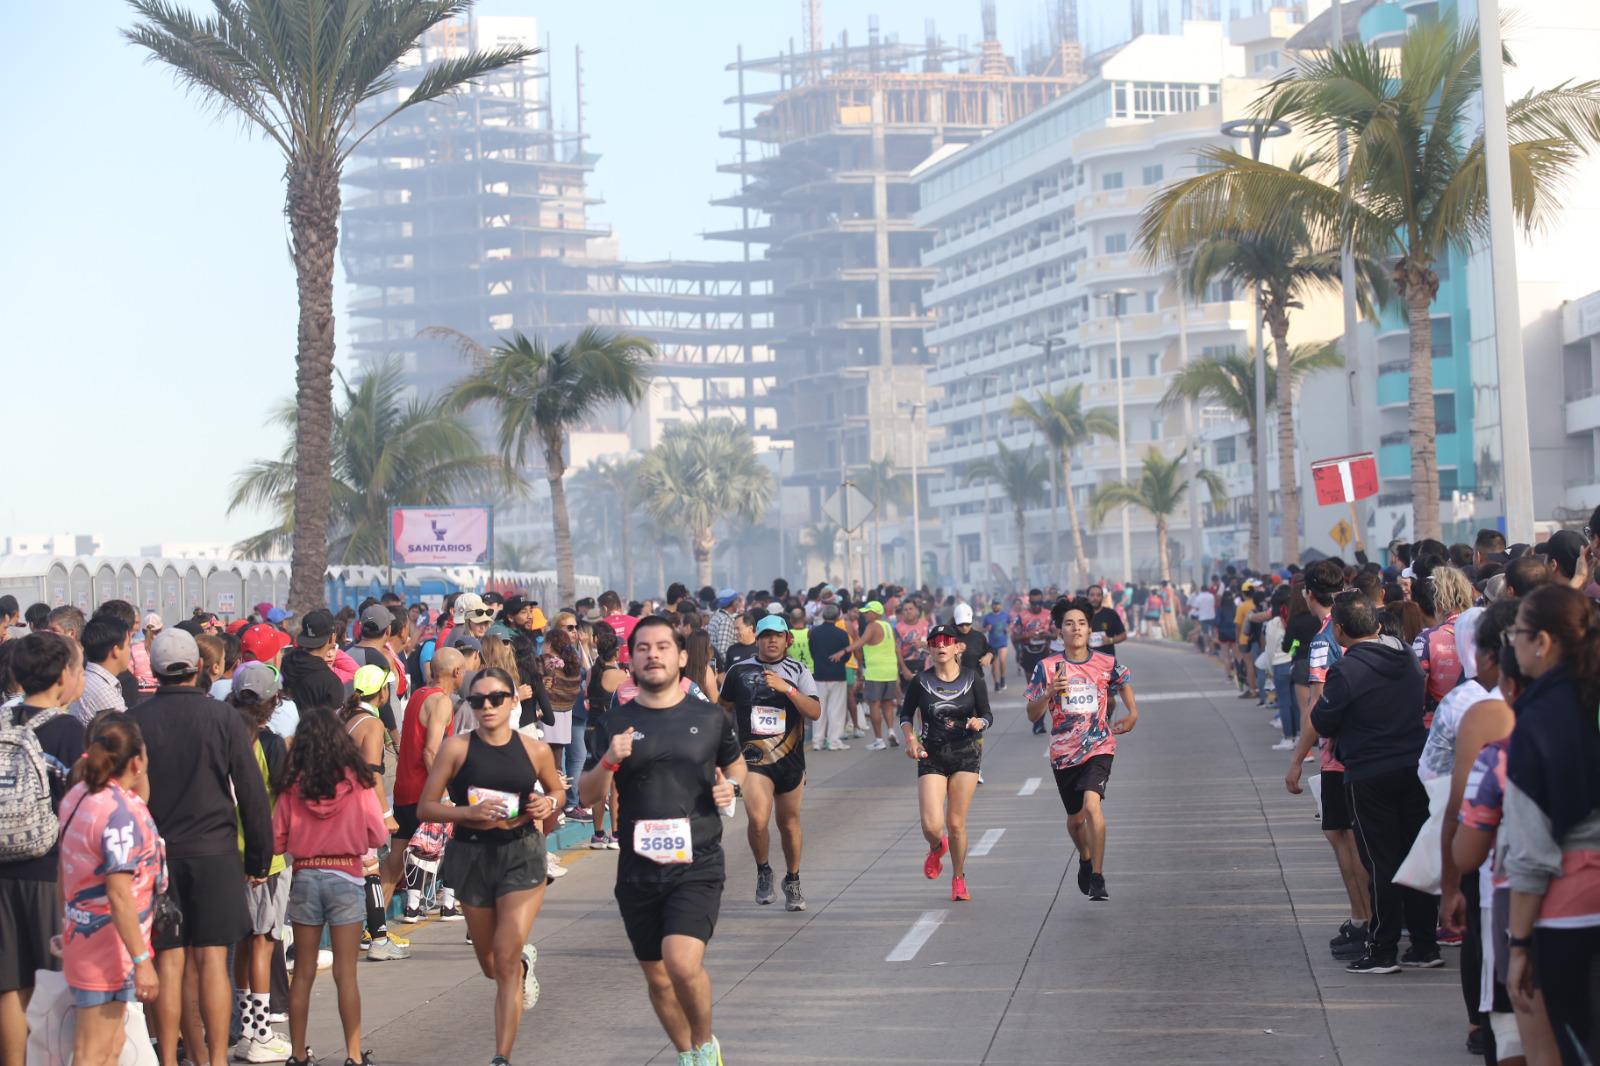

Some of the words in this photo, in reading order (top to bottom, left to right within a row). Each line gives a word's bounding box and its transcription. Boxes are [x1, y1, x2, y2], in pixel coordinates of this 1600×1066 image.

[408, 544, 472, 553] SANITARIOS
[1065, 694, 1094, 705] 1409
[758, 716, 777, 726] 761
[640, 836, 686, 852] 3689
